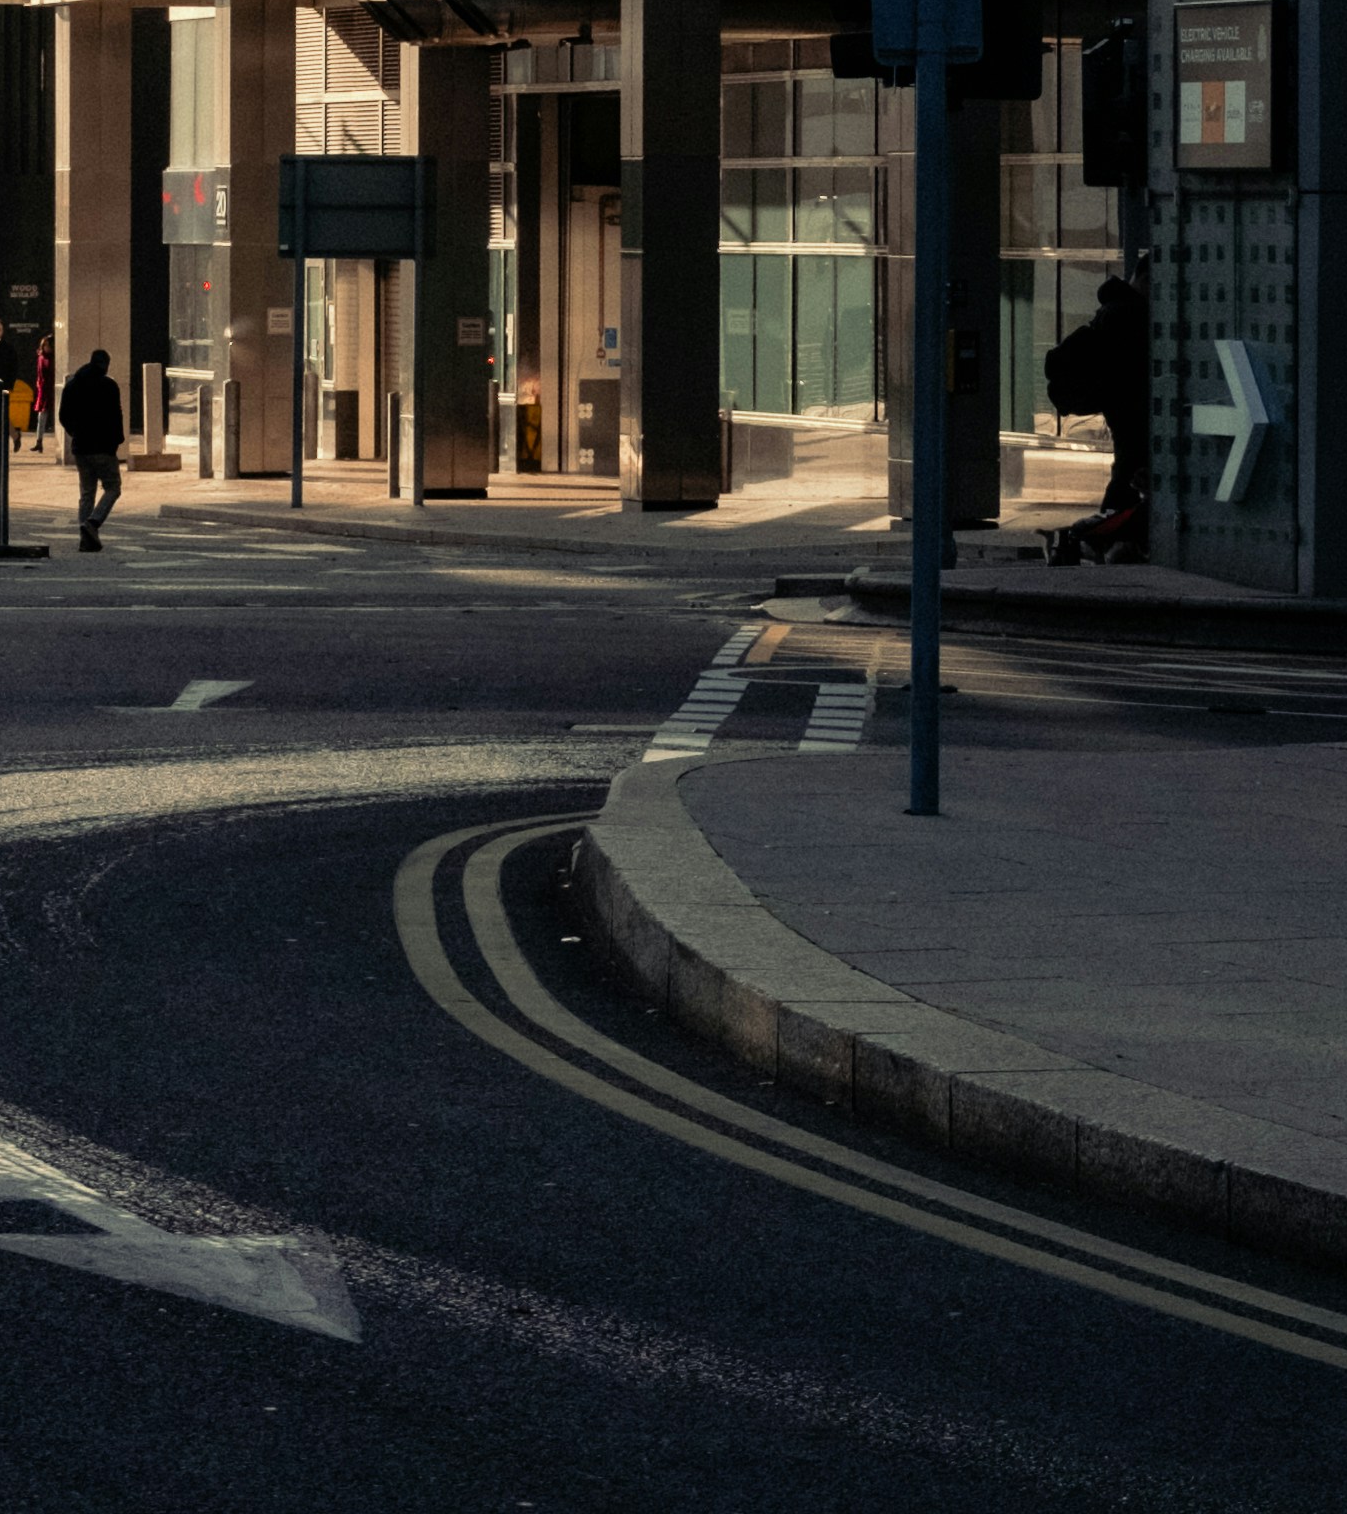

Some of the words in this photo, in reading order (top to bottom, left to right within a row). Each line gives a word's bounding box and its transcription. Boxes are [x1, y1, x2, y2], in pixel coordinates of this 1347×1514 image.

[1180, 26, 1211, 43] ELECTRIC
[1211, 25, 1241, 42] VEHICLE
[1180, 48, 1215, 64] CHARGING
[1215, 45, 1254, 62] AVAILABLE
